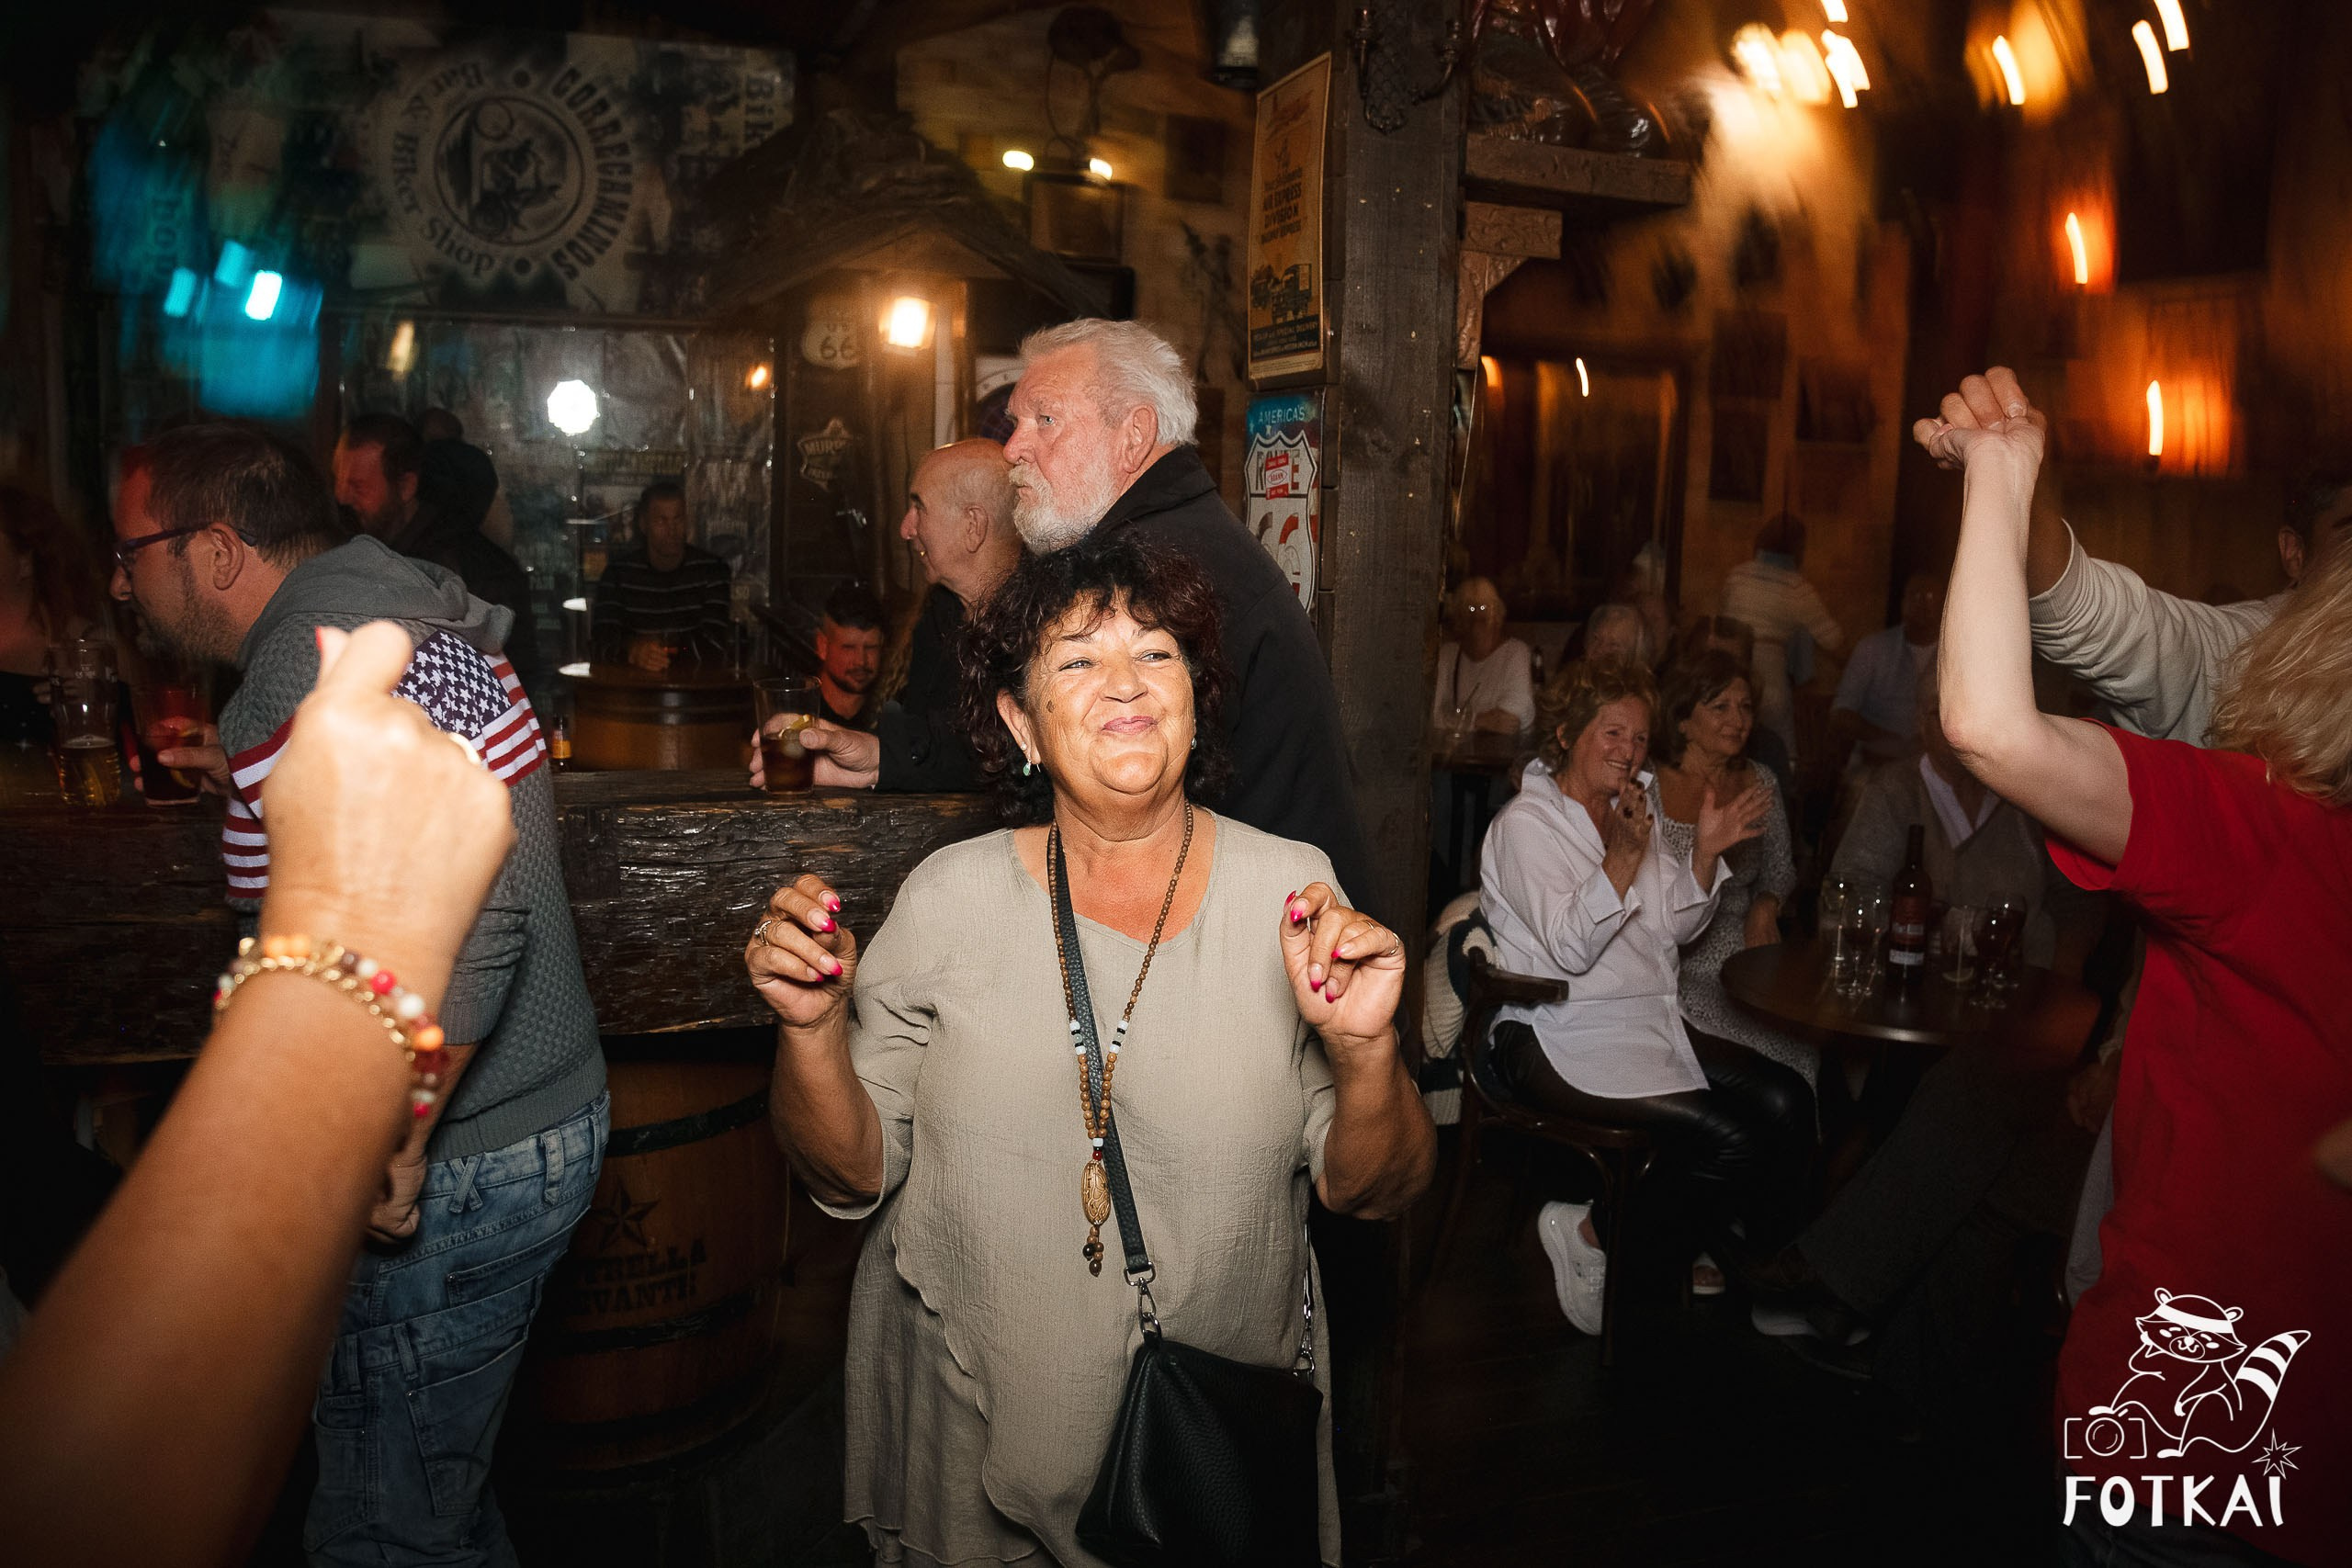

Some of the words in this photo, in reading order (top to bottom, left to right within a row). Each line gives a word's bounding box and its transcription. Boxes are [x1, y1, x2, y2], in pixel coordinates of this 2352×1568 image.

[553, 67, 633, 279] CORRECAMINOS
[425, 217, 494, 276] Shop
[1258, 405, 1306, 424] AMERICA'S
